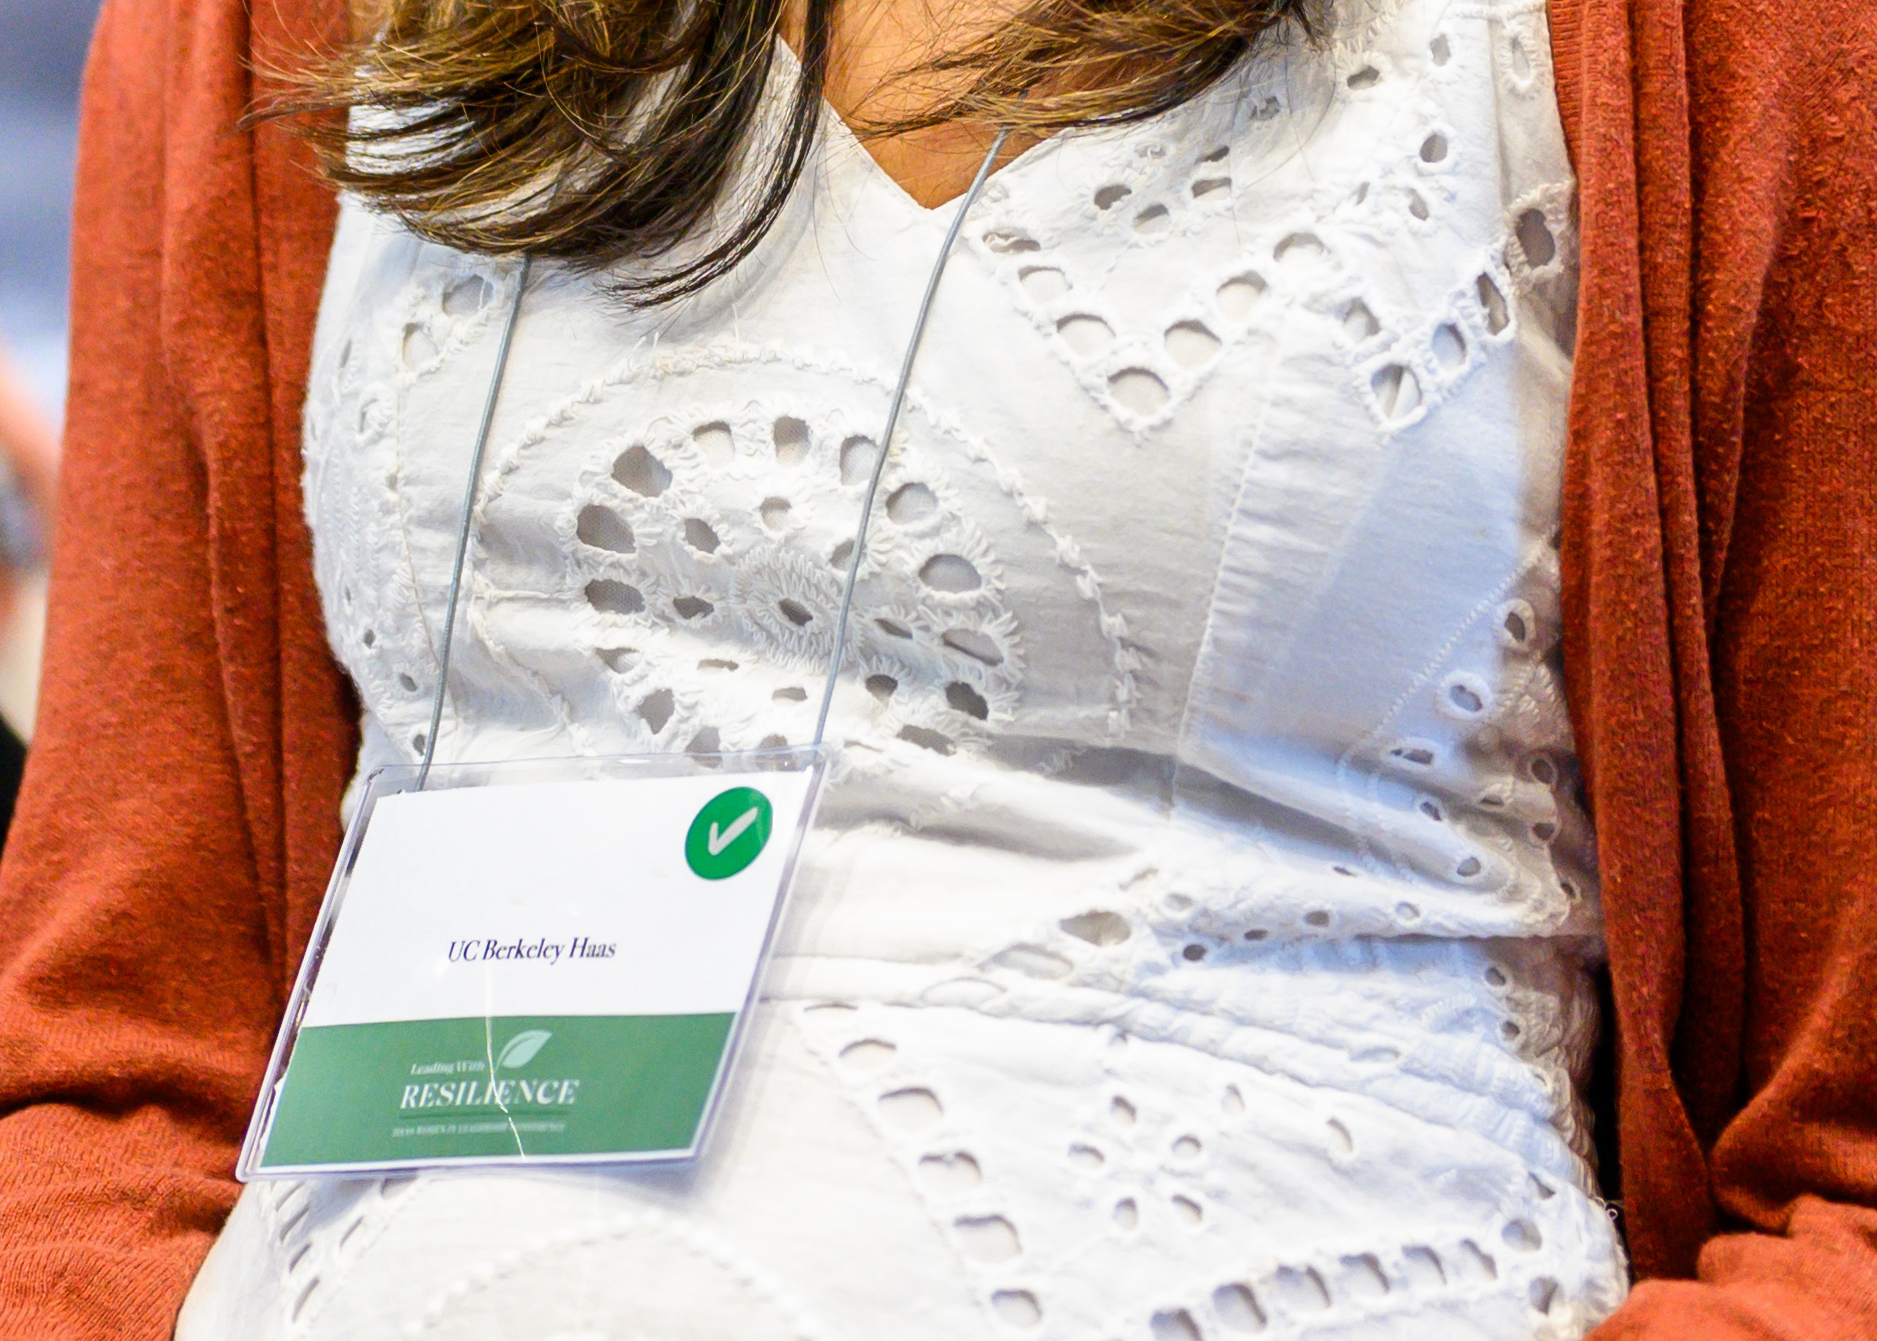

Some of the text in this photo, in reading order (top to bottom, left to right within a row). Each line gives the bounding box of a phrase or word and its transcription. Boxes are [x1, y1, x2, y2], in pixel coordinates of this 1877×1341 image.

[448, 937, 617, 965] UC Berkeley Haas
[400, 1079, 580, 1109] RESILIENCE
